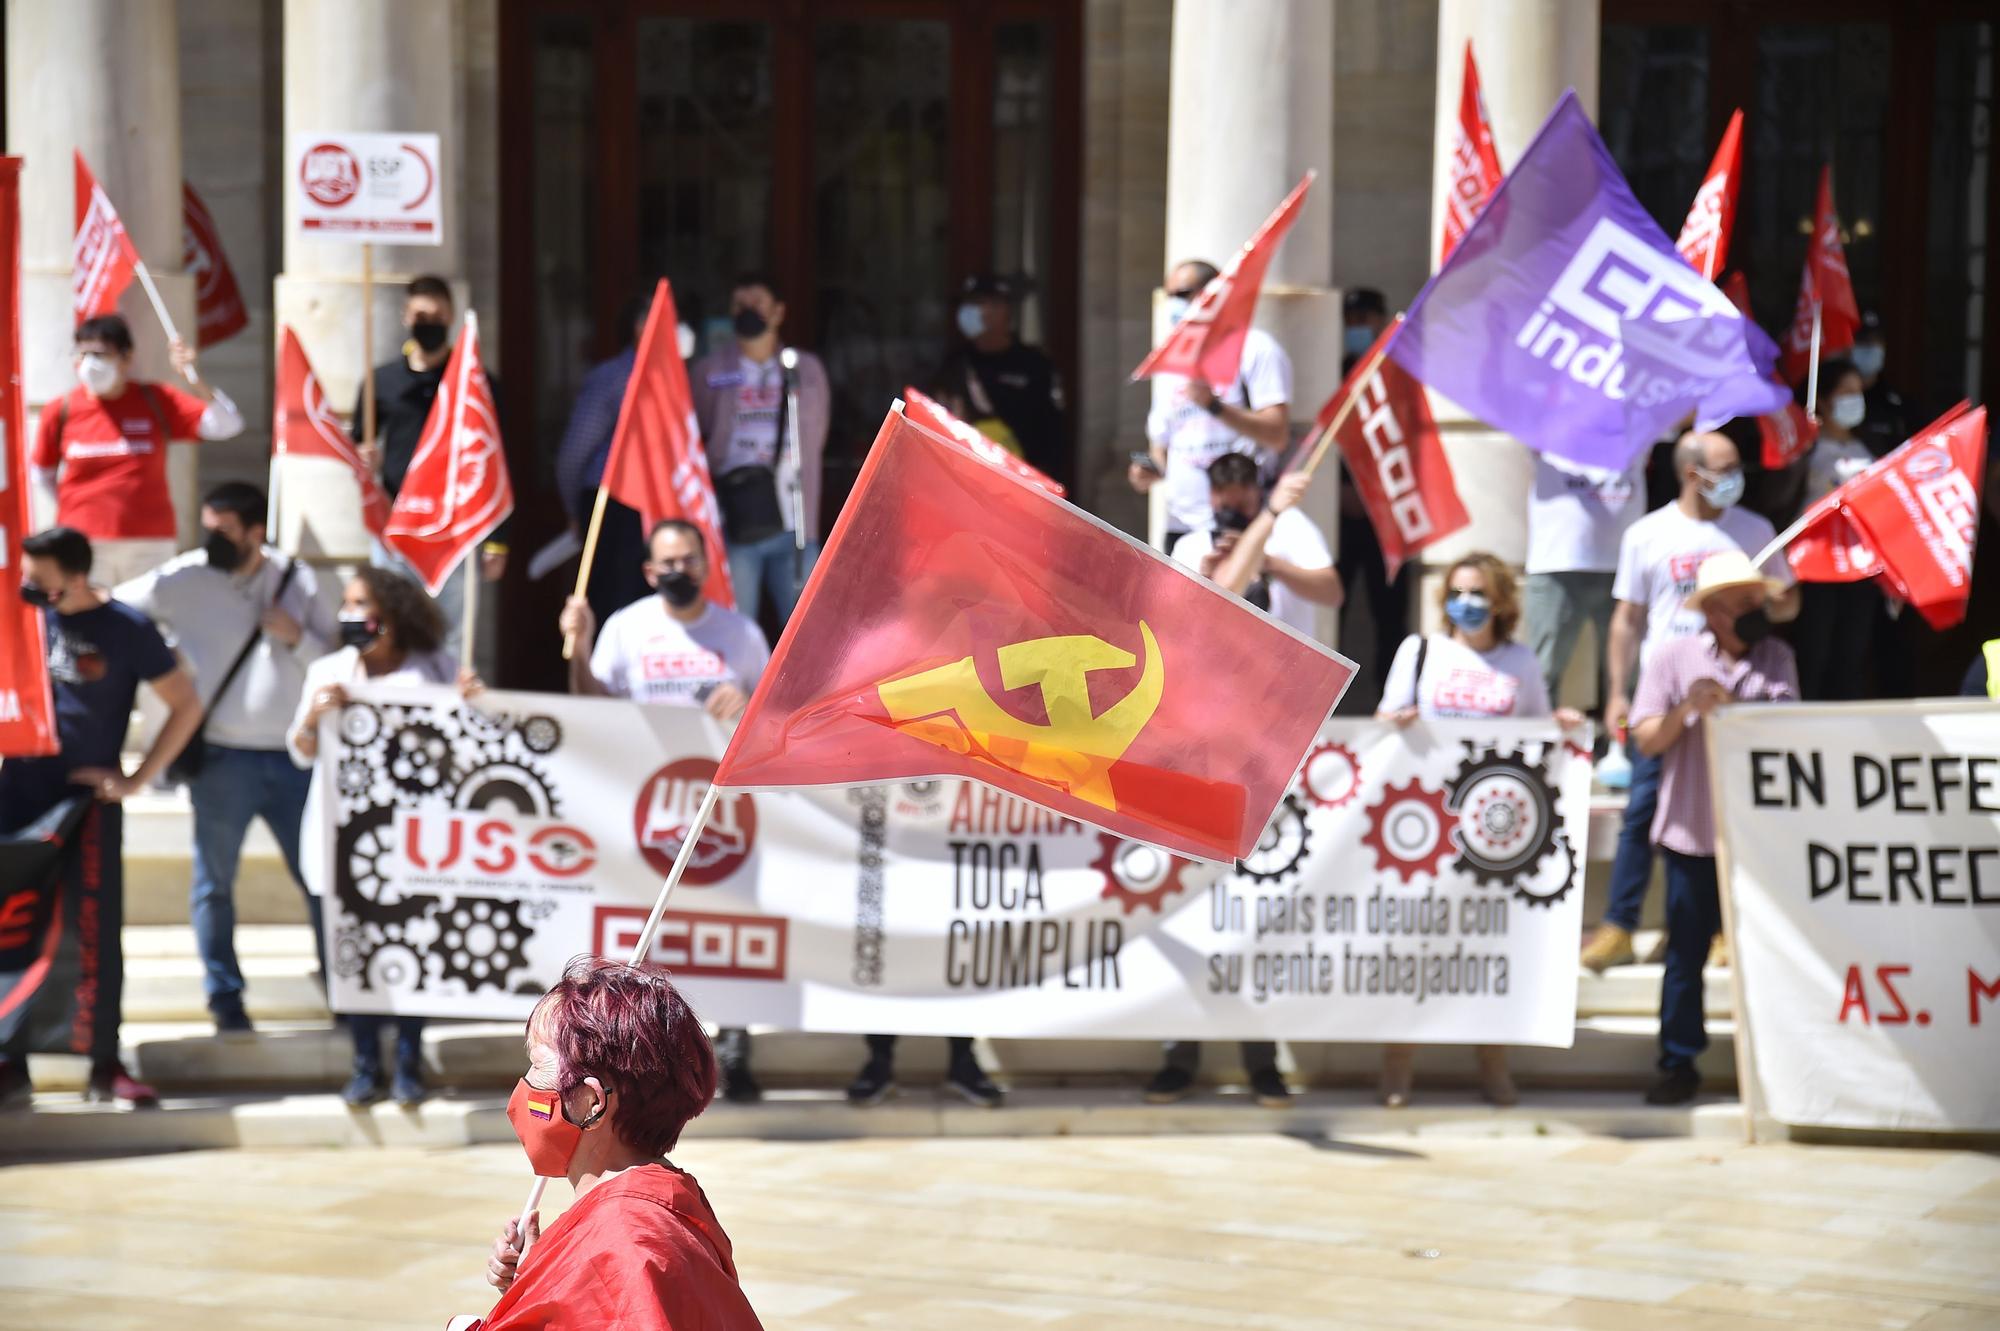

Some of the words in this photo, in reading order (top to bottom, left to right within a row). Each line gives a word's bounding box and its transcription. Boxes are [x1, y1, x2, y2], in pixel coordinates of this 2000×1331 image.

[1353, 366, 1435, 545] CCOO
[649, 777, 745, 836] UGT
[1750, 750, 1826, 809] EN
[405, 816, 597, 878] USO
[949, 840, 1046, 911] TOCA
[1807, 842, 2000, 905] DEREC
[602, 915, 780, 971] CCOO
[1210, 882, 1245, 933] Un
[1254, 885, 1315, 942] país
[1325, 895, 1357, 935] en
[1367, 883, 1449, 936] deuda
[1458, 896, 1509, 936] con
[946, 918, 1124, 991] CUMPLIR
[1208, 953, 1243, 995] su
[1253, 941, 1333, 1003] gente
[1343, 941, 1508, 1004] trabajadora
